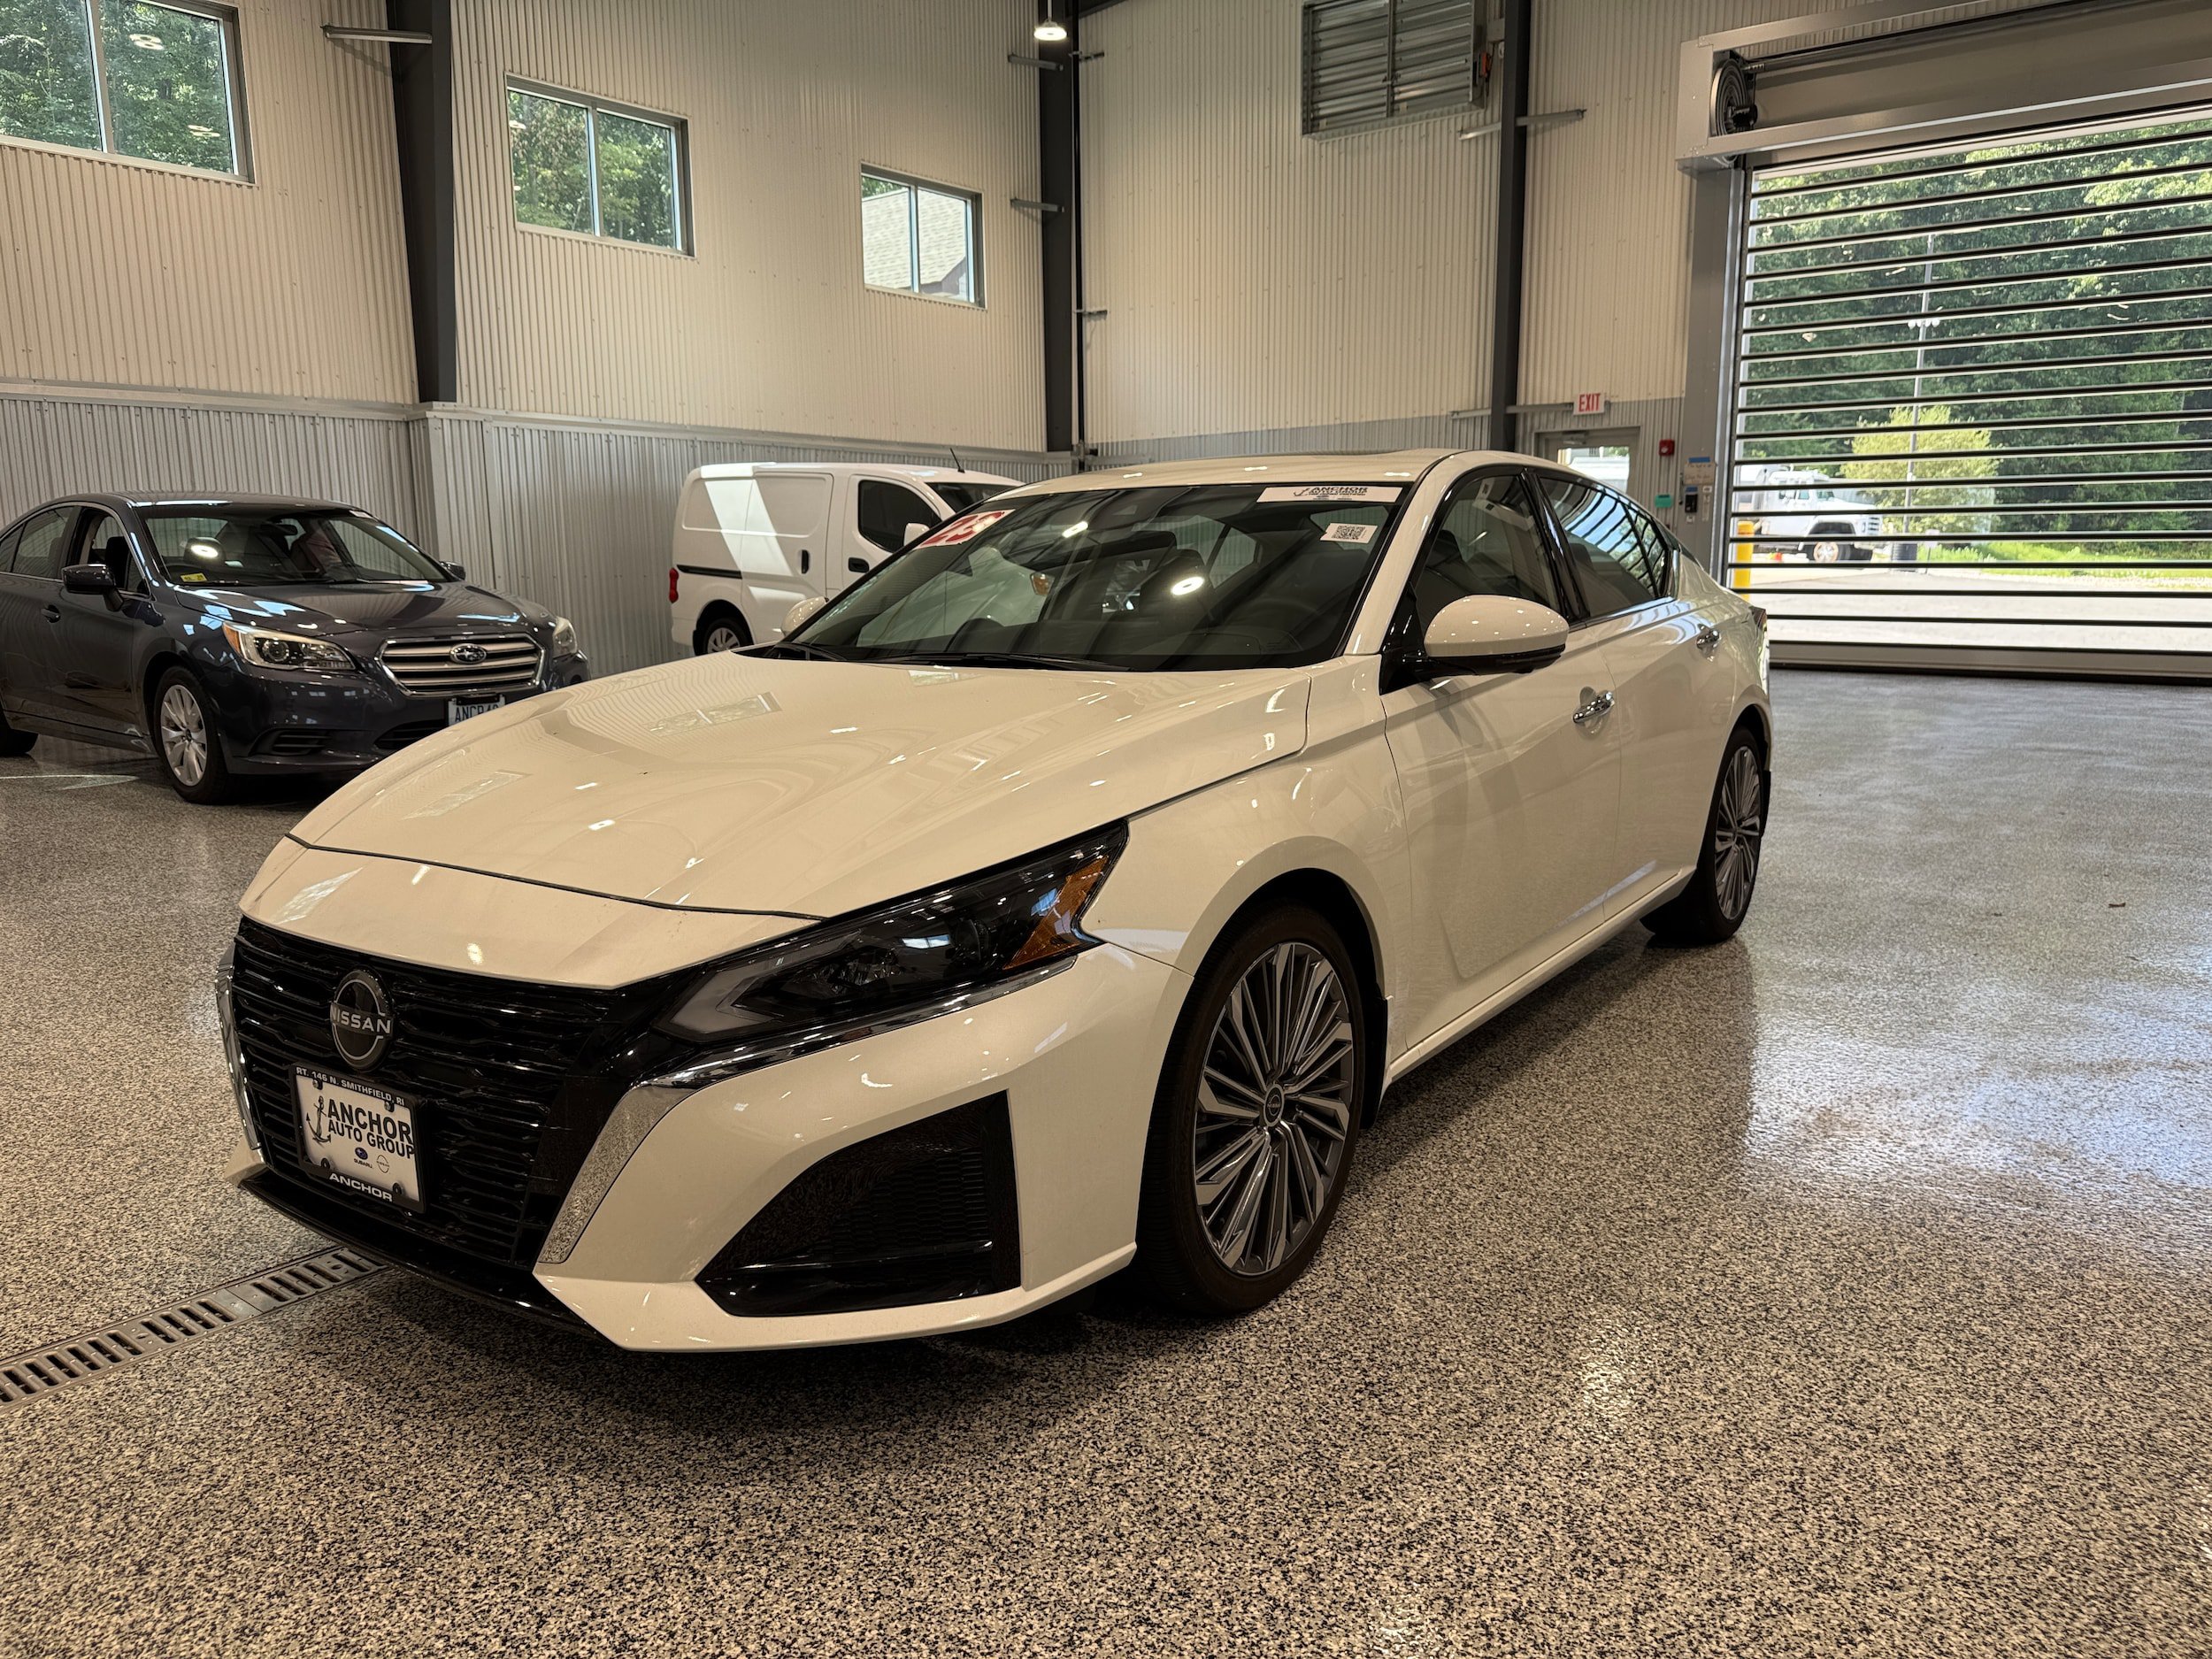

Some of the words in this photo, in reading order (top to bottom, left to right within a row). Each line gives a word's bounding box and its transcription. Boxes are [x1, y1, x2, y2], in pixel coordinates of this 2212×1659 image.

[1578, 393, 1601, 412] EXIT
[330, 1004, 391, 1033] NISSAN
[296, 1066, 309, 1077] RT.
[311, 1071, 328, 1081] 146
[330, 1076, 339, 1085] N.
[341, 1079, 395, 1102] SMITHFIELD,
[396, 1097, 405, 1106] RI
[328, 1099, 414, 1145] ANCHOR
[328, 1119, 363, 1142] AUTO
[367, 1132, 415, 1159] GROUP
[329, 1172, 393, 1202] ANCHOR
